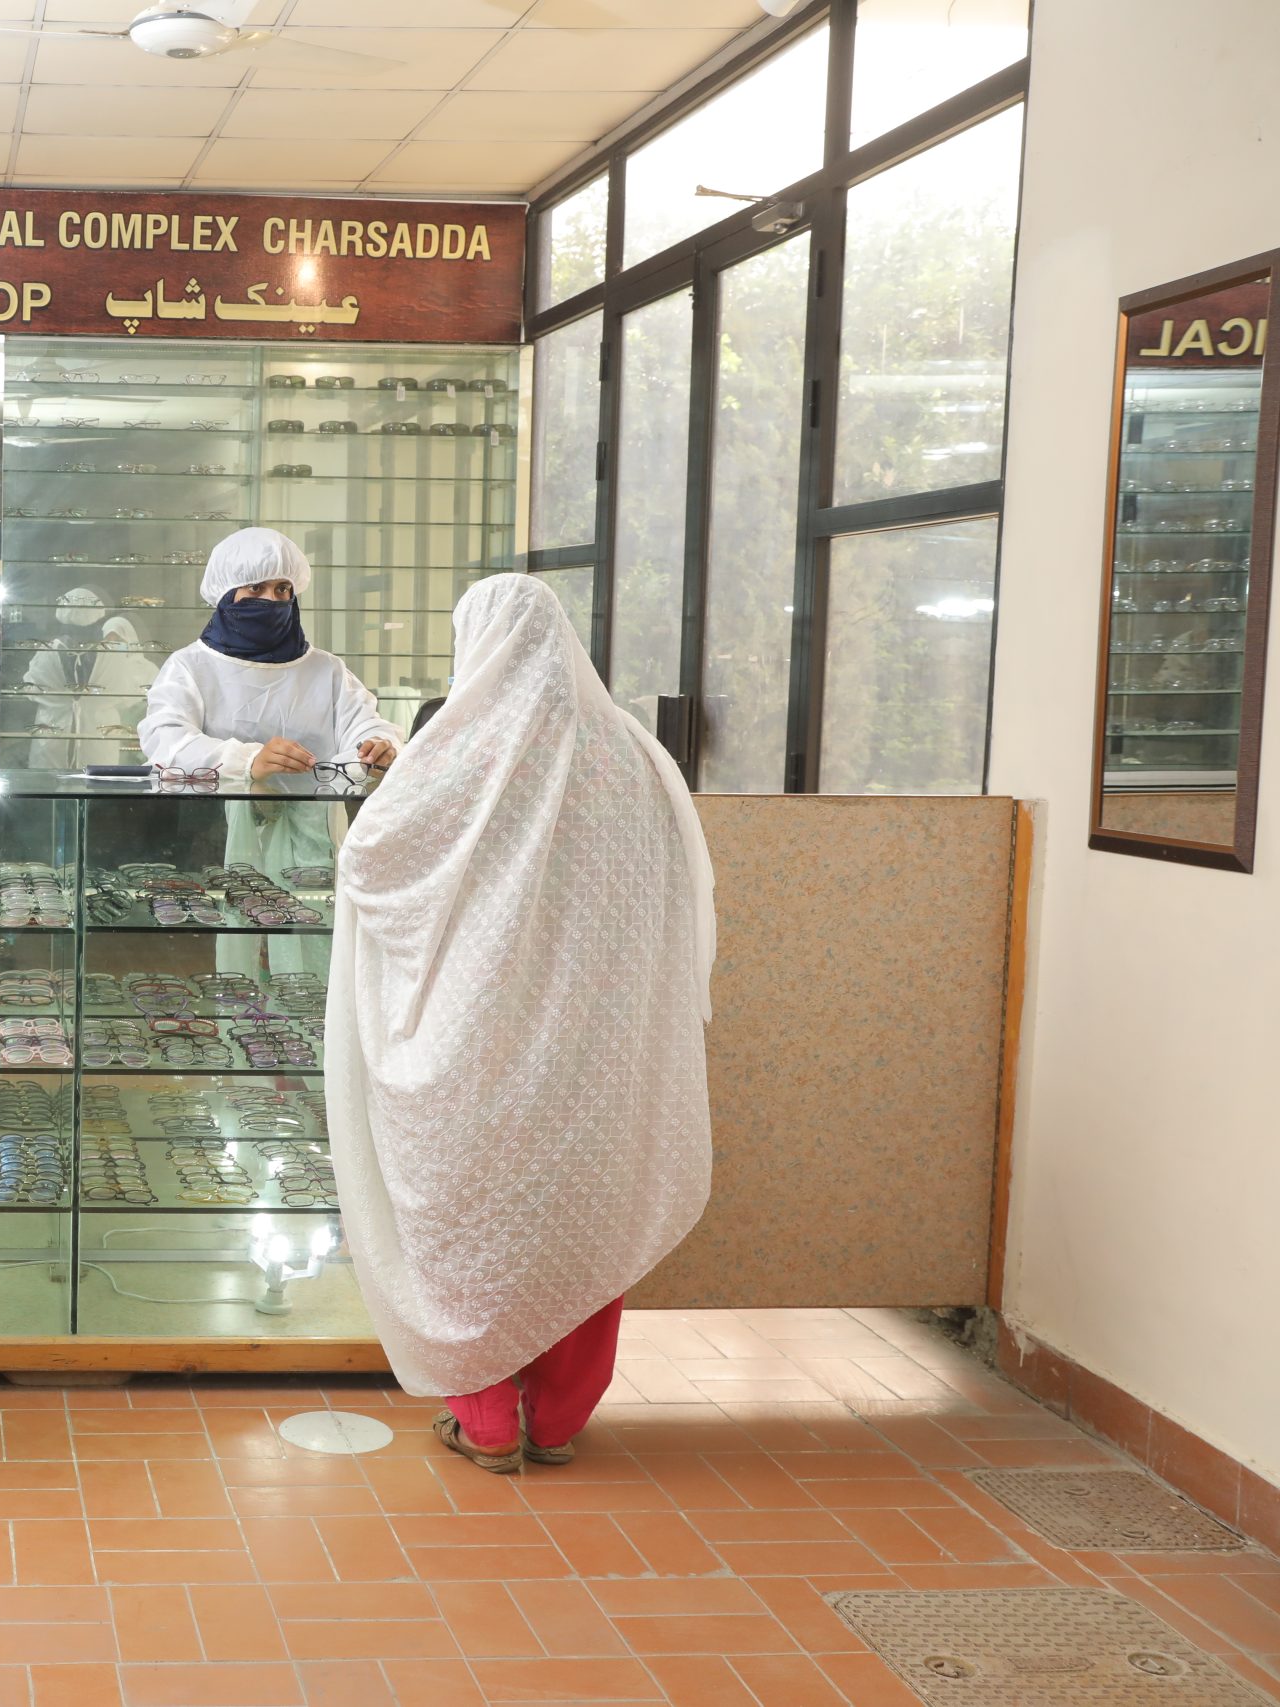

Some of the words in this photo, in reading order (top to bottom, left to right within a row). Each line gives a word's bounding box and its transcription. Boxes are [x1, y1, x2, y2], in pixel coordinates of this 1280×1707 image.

[58, 211, 239, 252] COMPLEX
[263, 217, 492, 261] CHARSADDA
[106, 277, 206, 335] شاپ
